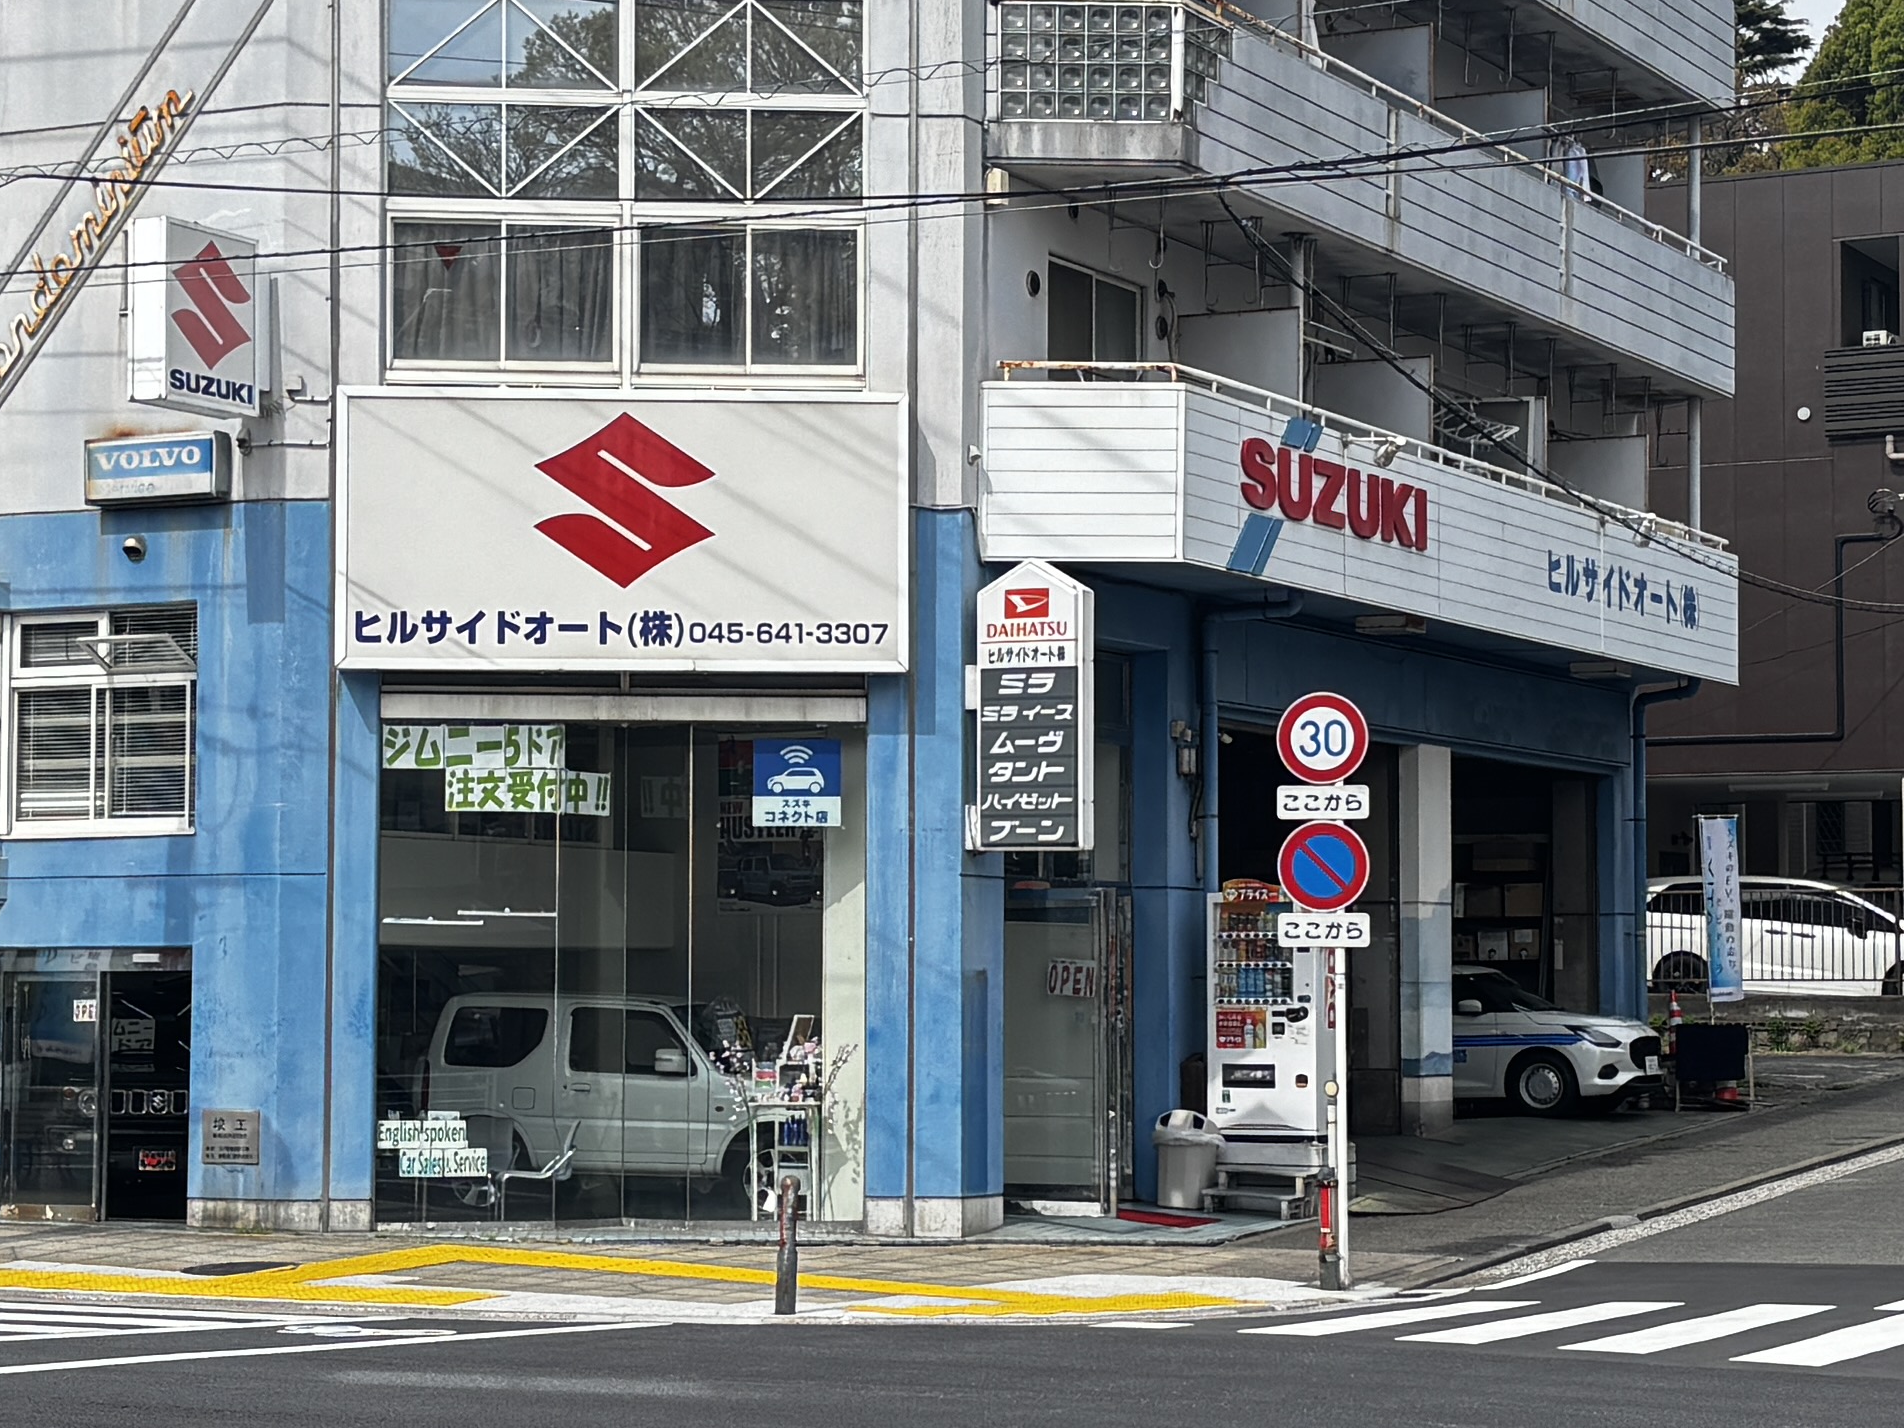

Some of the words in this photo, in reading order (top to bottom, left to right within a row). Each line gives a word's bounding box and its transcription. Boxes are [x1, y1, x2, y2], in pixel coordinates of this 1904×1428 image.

[169, 368, 254, 405] SUZUKI
[95, 445, 201, 471] VOLVO
[1240, 436, 1428, 552] SUZUKI
[1547, 549, 1699, 630] ヒルサイドオート(株)
[353, 610, 684, 648] ヒルサイドオート(株)
[688, 622, 890, 646] 045-641-3307
[987, 621, 1067, 638] DAIHATSU
[998, 673, 1056, 695] ミラ
[1022, 704, 1074, 721] イース
[384, 726, 564, 768] ジムニー5ドア
[989, 731, 1065, 754] ムーヴ
[1299, 719, 1347, 758] 30
[988, 762, 1065, 782] タント
[982, 792, 1073, 810] ハイゼット
[1283, 793, 1363, 812] ここから
[764, 810, 829, 824] コネクト店
[989, 819, 1065, 841] ブーン
[1284, 922, 1364, 941] ここから
[1049, 964, 1094, 997] OPEN
[378, 1121, 421, 1147] English
